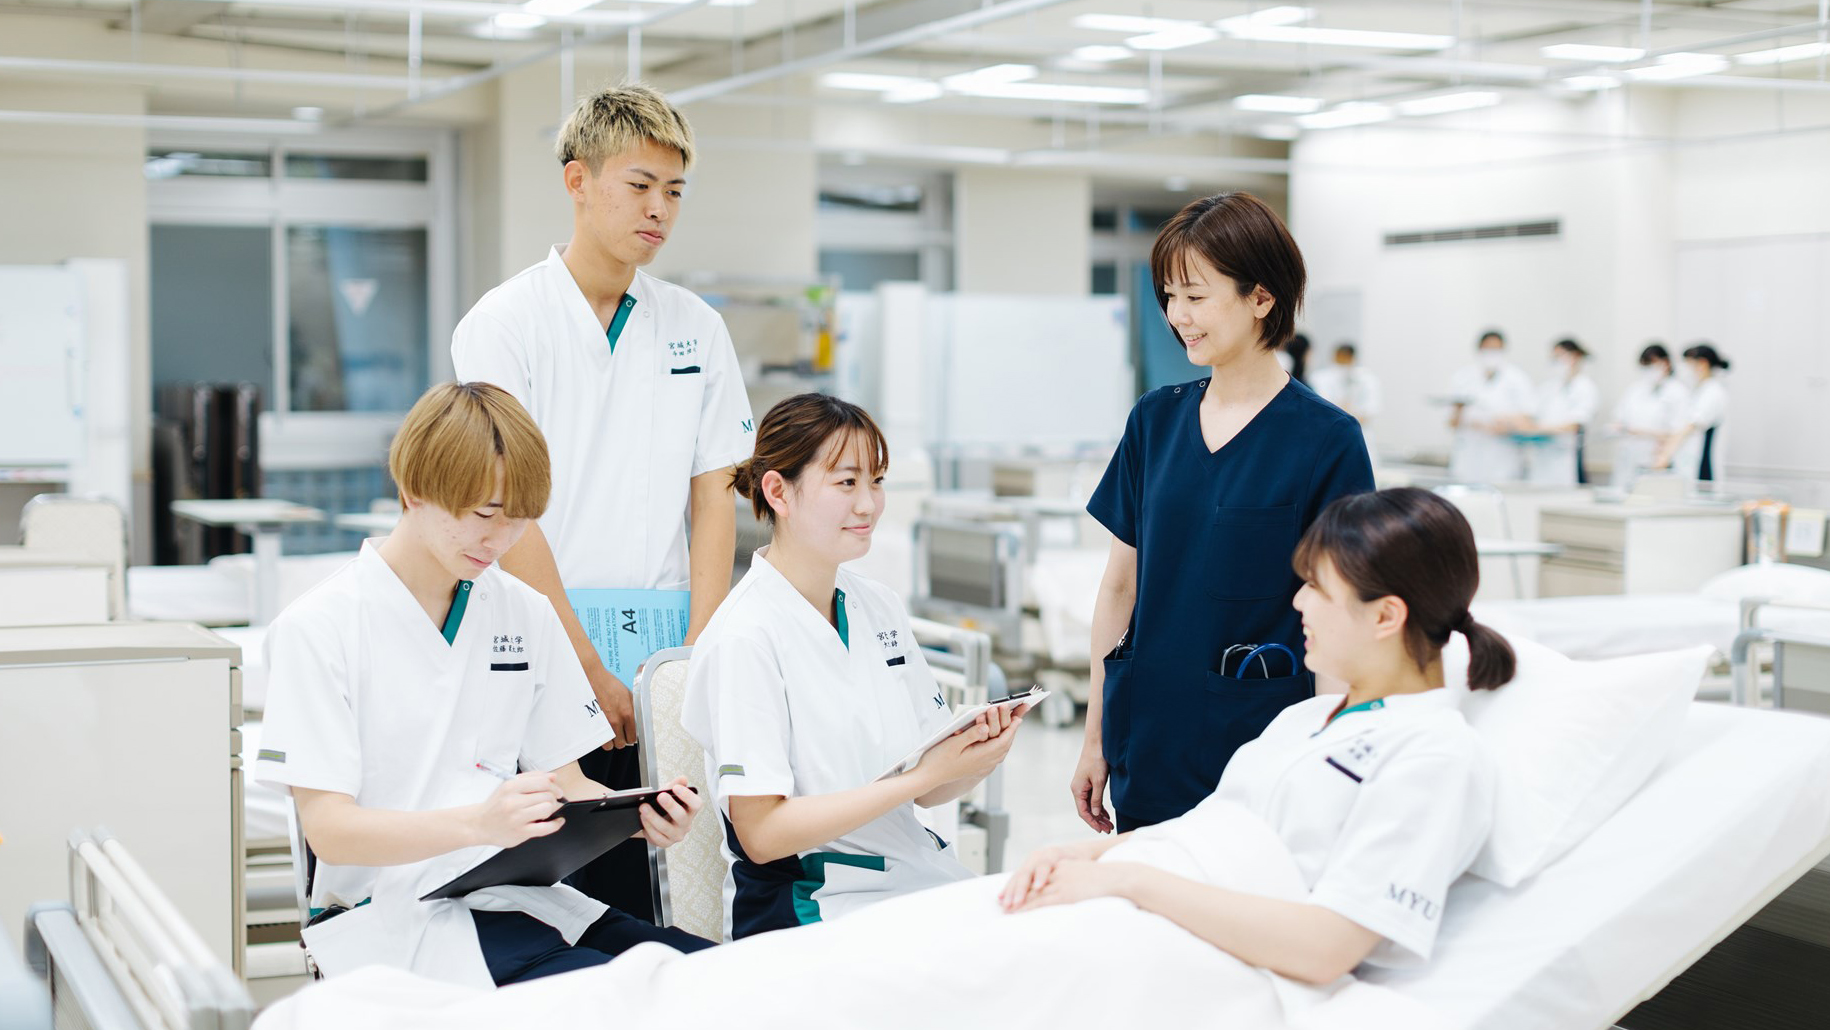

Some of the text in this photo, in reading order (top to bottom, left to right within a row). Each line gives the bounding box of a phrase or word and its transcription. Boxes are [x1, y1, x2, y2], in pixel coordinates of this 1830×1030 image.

[606, 627, 612, 636] NO
[621, 608, 637, 635] A4
[1385, 882, 1440, 921] MYU
